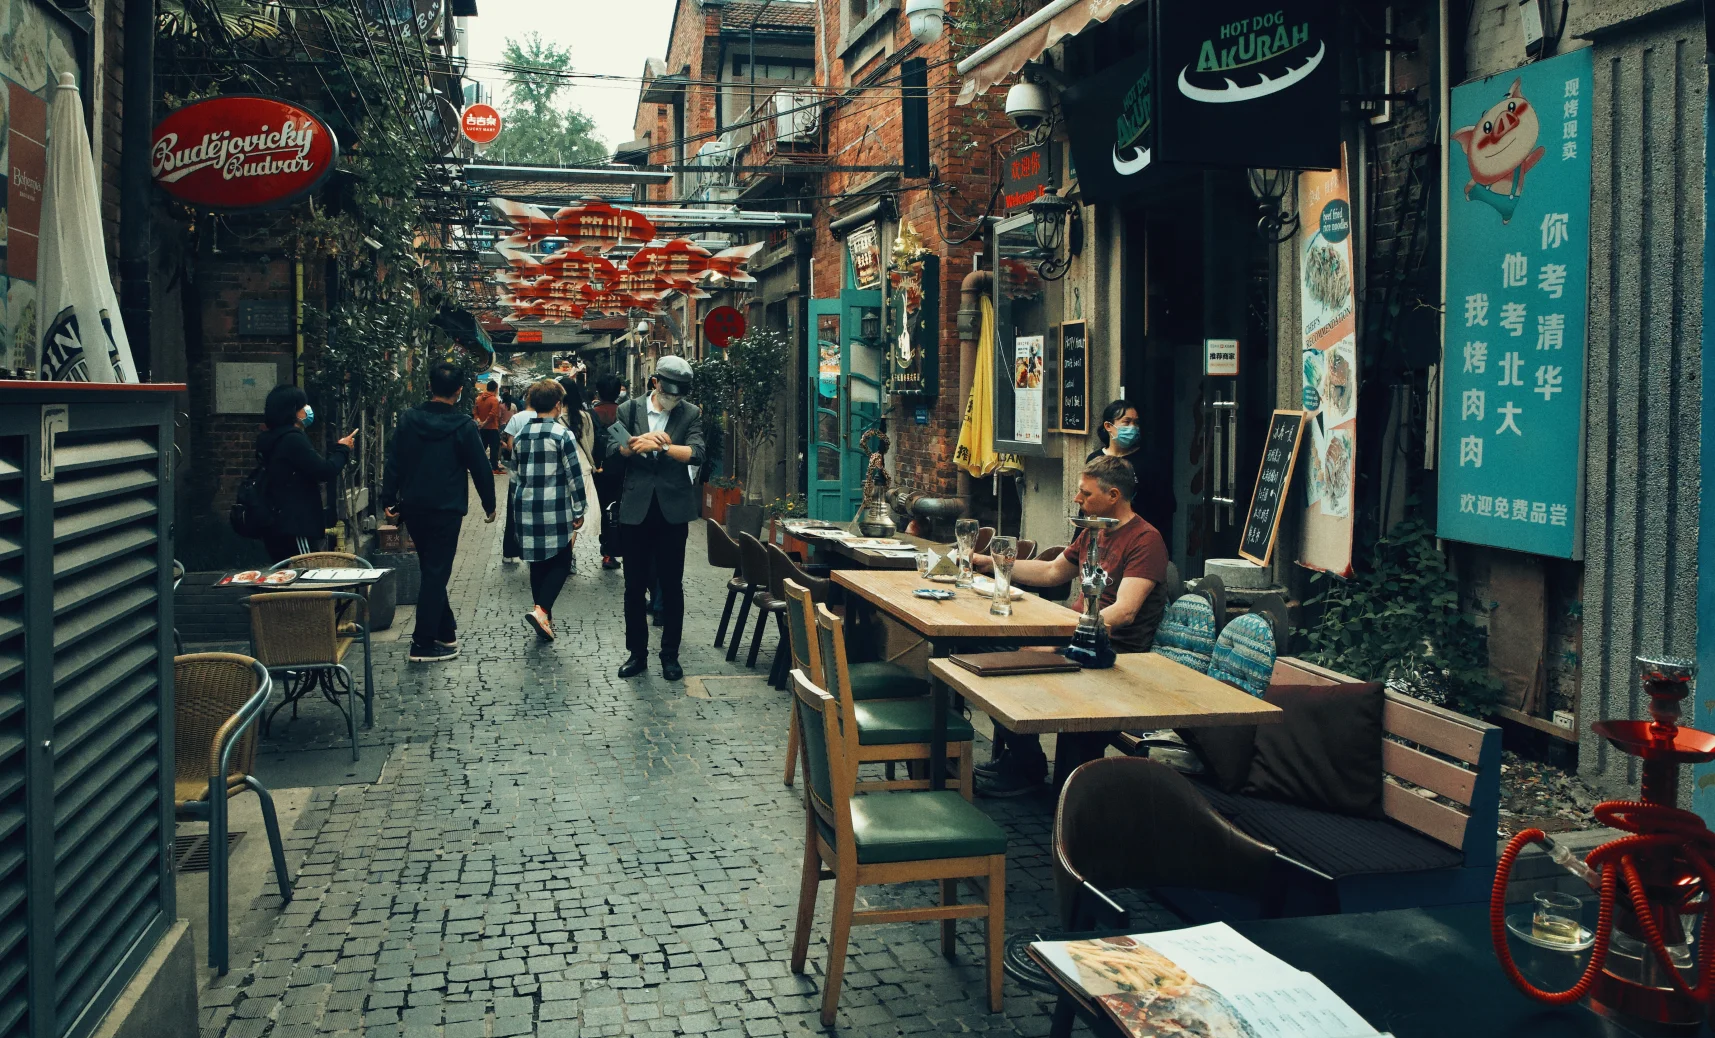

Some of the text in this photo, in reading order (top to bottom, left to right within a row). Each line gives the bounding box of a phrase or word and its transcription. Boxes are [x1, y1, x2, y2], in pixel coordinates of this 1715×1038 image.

[1220, 10, 1284, 39] HOT DOG
[1562, 78, 1579, 161] 现烤现卖
[152, 121, 312, 178] Budějovický
[222, 155, 314, 180] Budvar
[1006, 190, 1036, 208] Welcome
[1305, 316, 1321, 335] CHEF'S
[1534, 212, 1568, 401] 你考清华
[1306, 306, 1351, 349] RECOMMENDATION
[1496, 252, 1528, 436] 他考北大
[1210, 352, 1235, 361] 推荐商家
[1459, 293, 1489, 468] 我烤肉肉
[1460, 493, 1568, 527] 欢迎免费品尝
